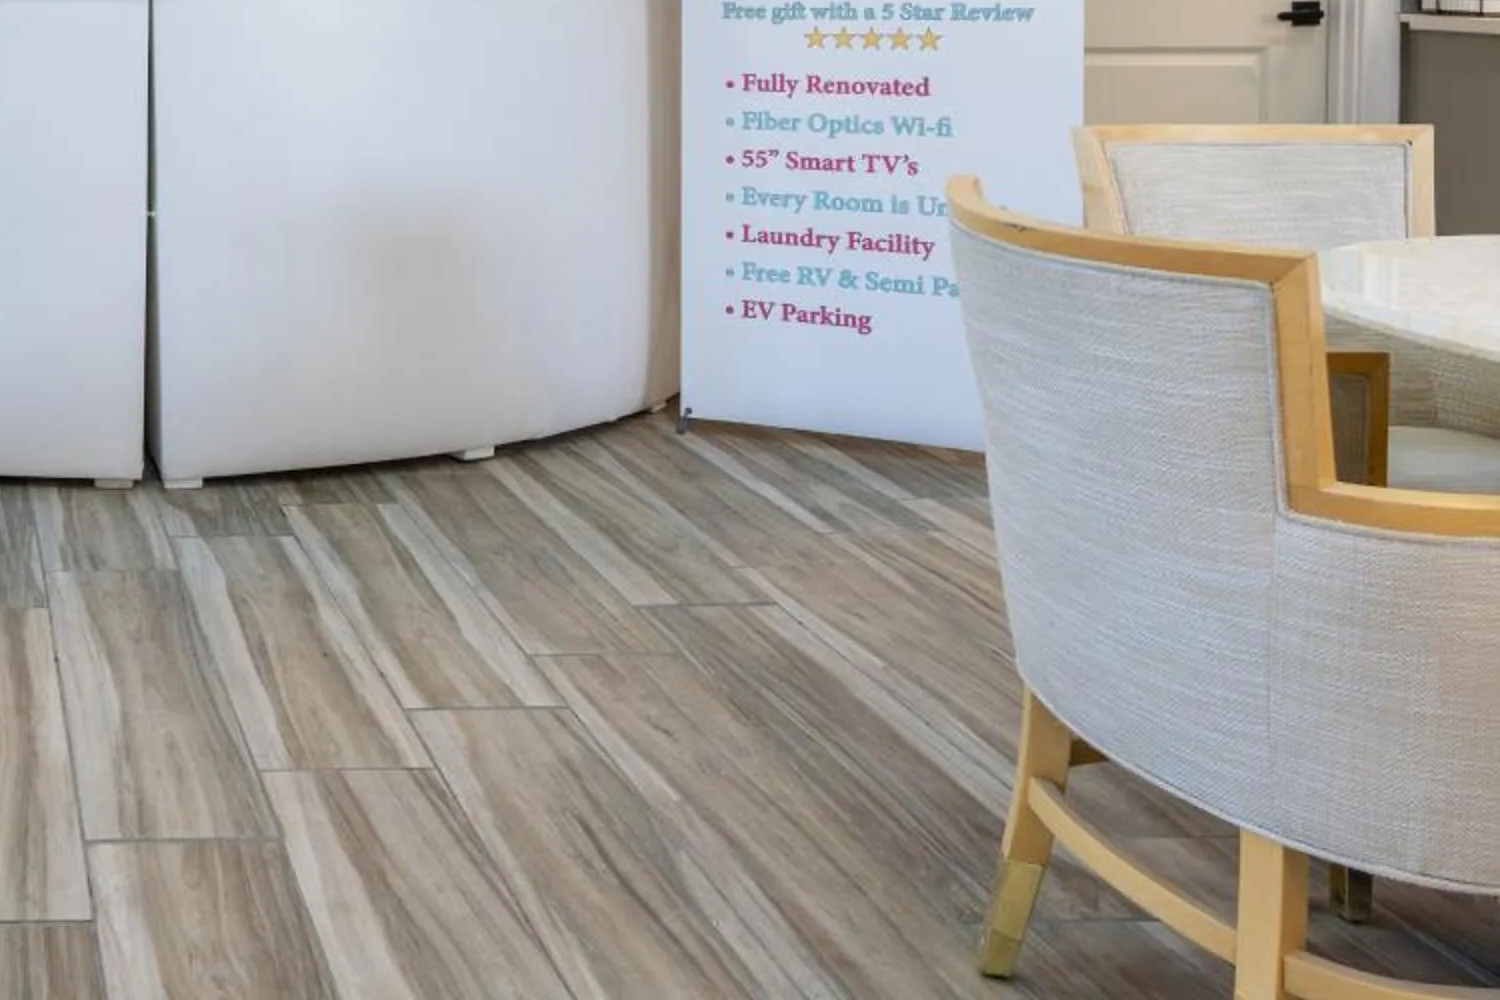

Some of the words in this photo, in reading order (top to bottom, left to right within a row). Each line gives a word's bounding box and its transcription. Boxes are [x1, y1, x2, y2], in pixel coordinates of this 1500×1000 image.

[722, 2, 767, 20] Free
[771, 2, 806, 25] gift
[809, 3, 860, 21] with
[864, 7, 876, 21] a
[881, 3, 895, 20] 5
[900, 3, 944, 21] Star
[950, 3, 1035, 22] Review
[742, 73, 799, 99] Fully
[806, 76, 930, 97] Renovated
[742, 111, 800, 132] Fiber
[807, 113, 884, 139] Optics
[891, 116, 954, 138] Wi-fi
[785, 151, 855, 172] Smart
[742, 187, 806, 213] Every
[813, 189, 883, 213] Room
[891, 193, 909, 215] is
[742, 224, 839, 252] Laundry
[848, 231, 935, 261] Facility
[742, 262, 789, 284] Free
[797, 265, 832, 286] RV
[838, 269, 858, 289] &
[865, 271, 923, 294] Semi
[742, 300, 775, 320] EV
[781, 303, 872, 334] Parking
